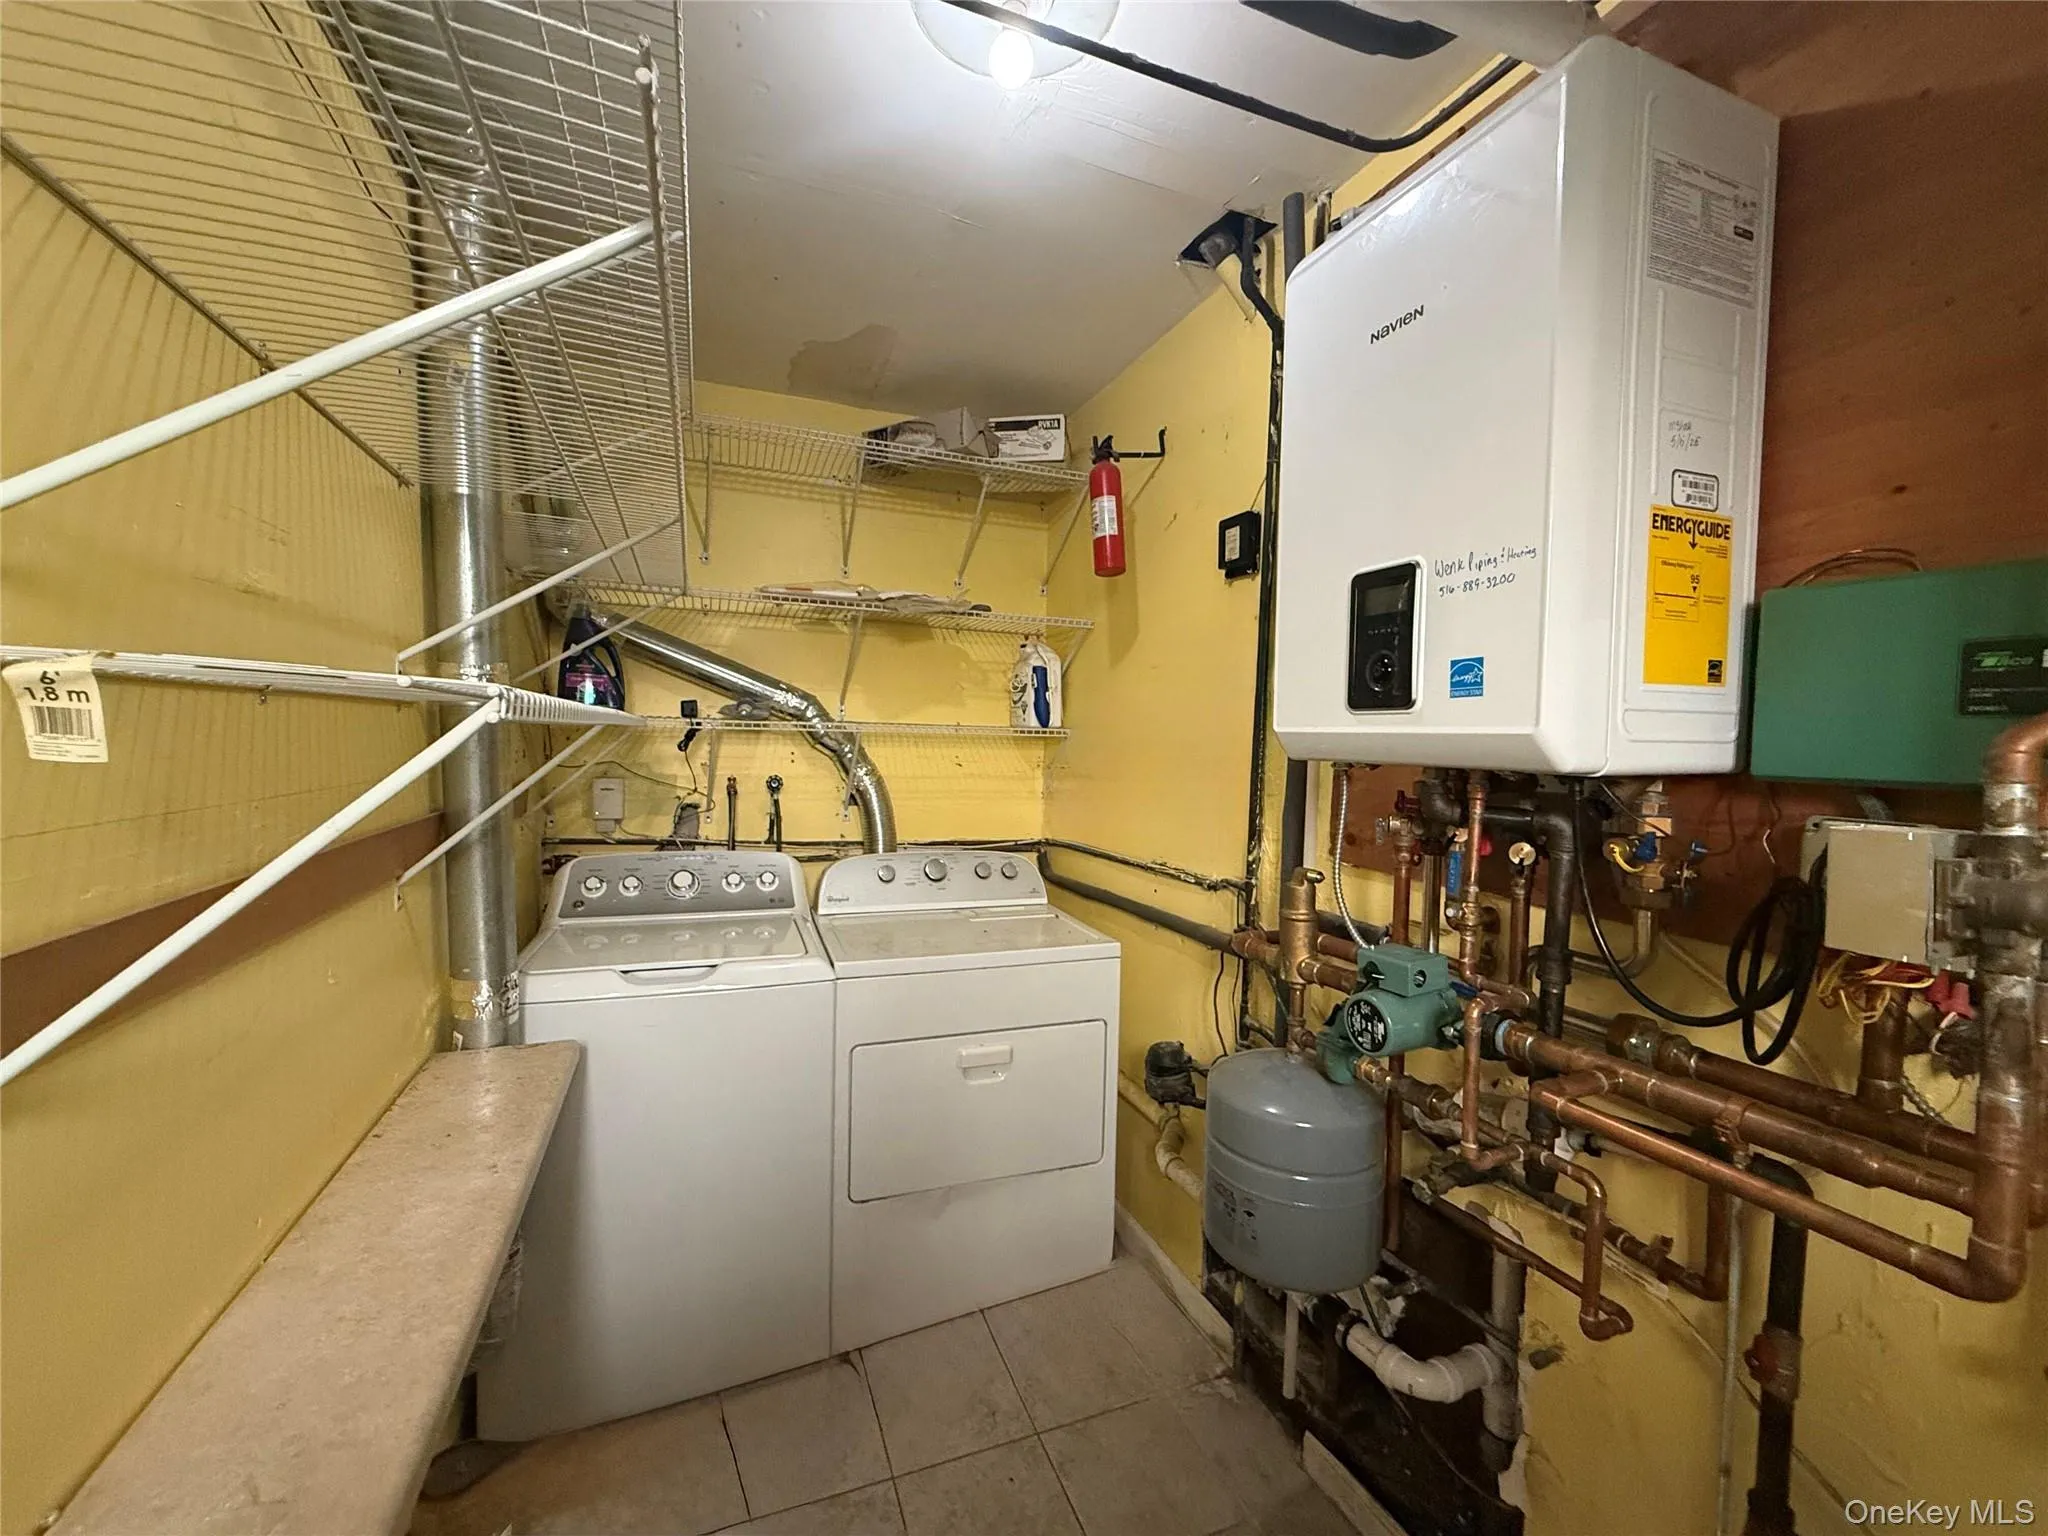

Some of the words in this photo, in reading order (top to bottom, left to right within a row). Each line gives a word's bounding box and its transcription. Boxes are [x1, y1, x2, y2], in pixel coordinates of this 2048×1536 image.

[1651, 512, 1731, 541] ENERGYGUIDE
[1434, 558, 1465, 578] Wenk
[1468, 551, 1498, 572] Piping
[1690, 574, 1700, 585] 95
[66, 690, 90, 703] m
